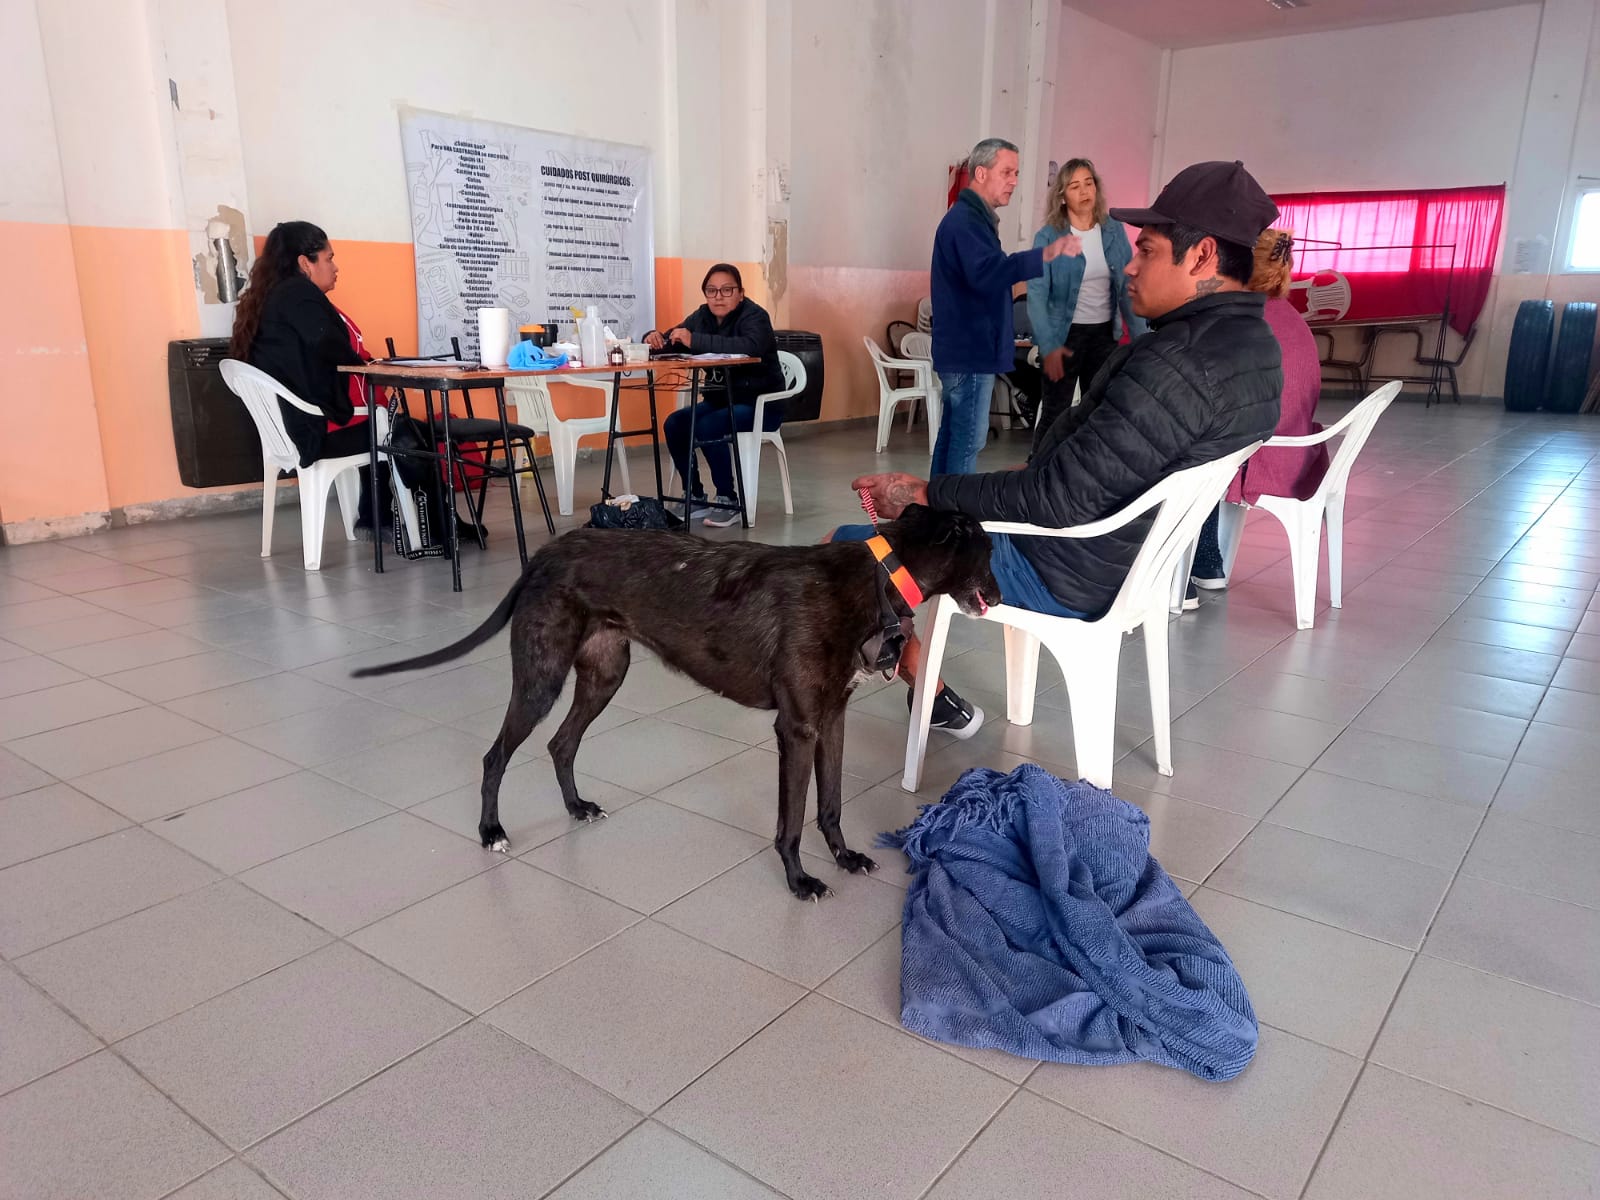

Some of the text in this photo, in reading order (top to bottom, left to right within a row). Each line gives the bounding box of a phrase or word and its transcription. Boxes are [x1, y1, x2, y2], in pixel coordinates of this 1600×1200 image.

[541, 165, 631, 186] CUIDADOS POST QUIRÚRGICOS
